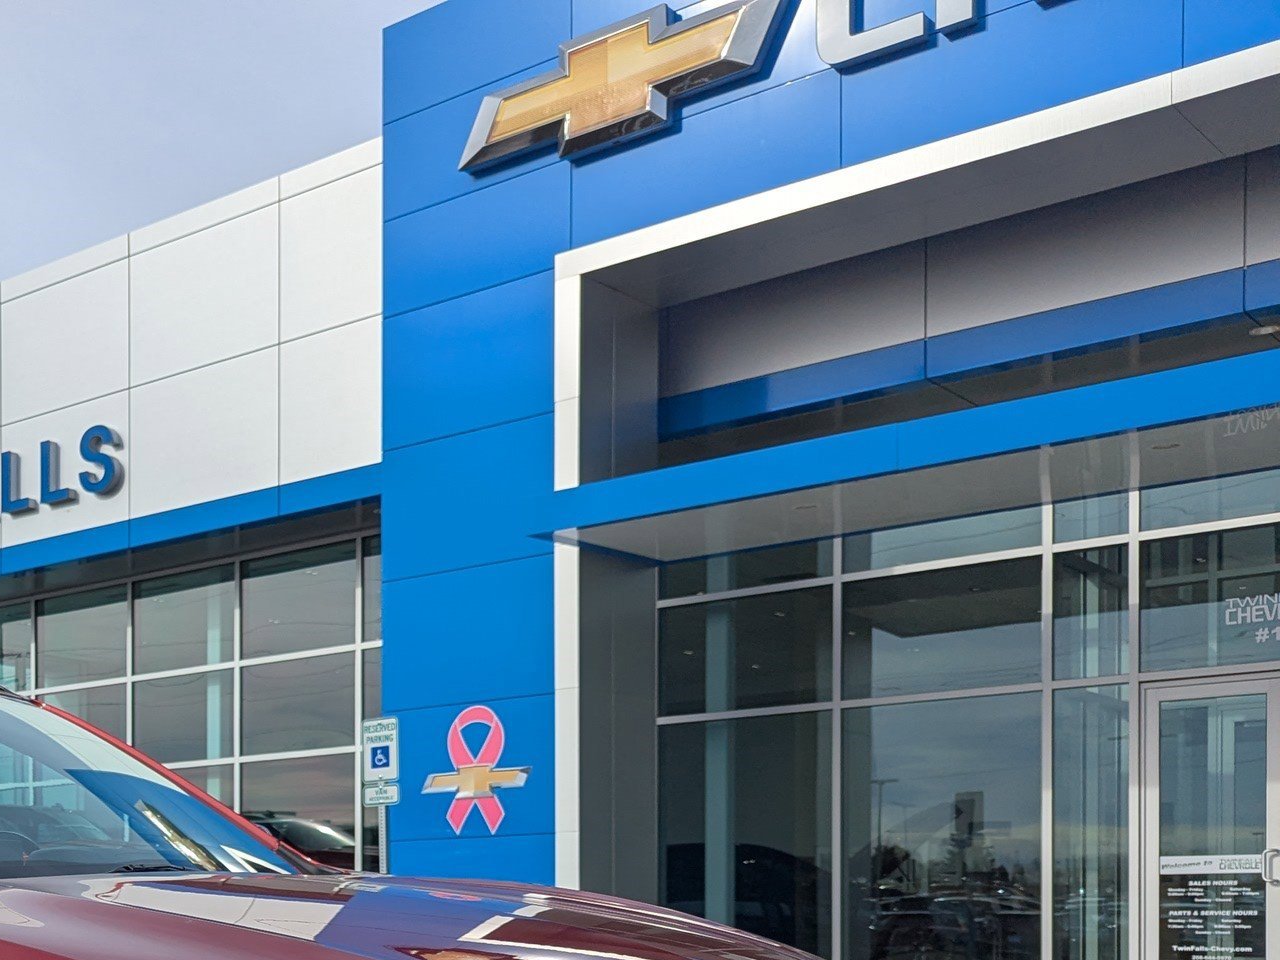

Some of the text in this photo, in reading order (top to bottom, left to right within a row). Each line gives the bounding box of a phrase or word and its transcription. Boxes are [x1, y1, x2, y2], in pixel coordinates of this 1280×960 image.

[1225, 593, 1280, 608] TWIN
[1225, 603, 1280, 626] CHEV
[364, 722, 396, 734] RESERVED
[366, 734, 394, 744] PARKING
[1172, 945, 1252, 953] TwinFalls-Chevy.com
